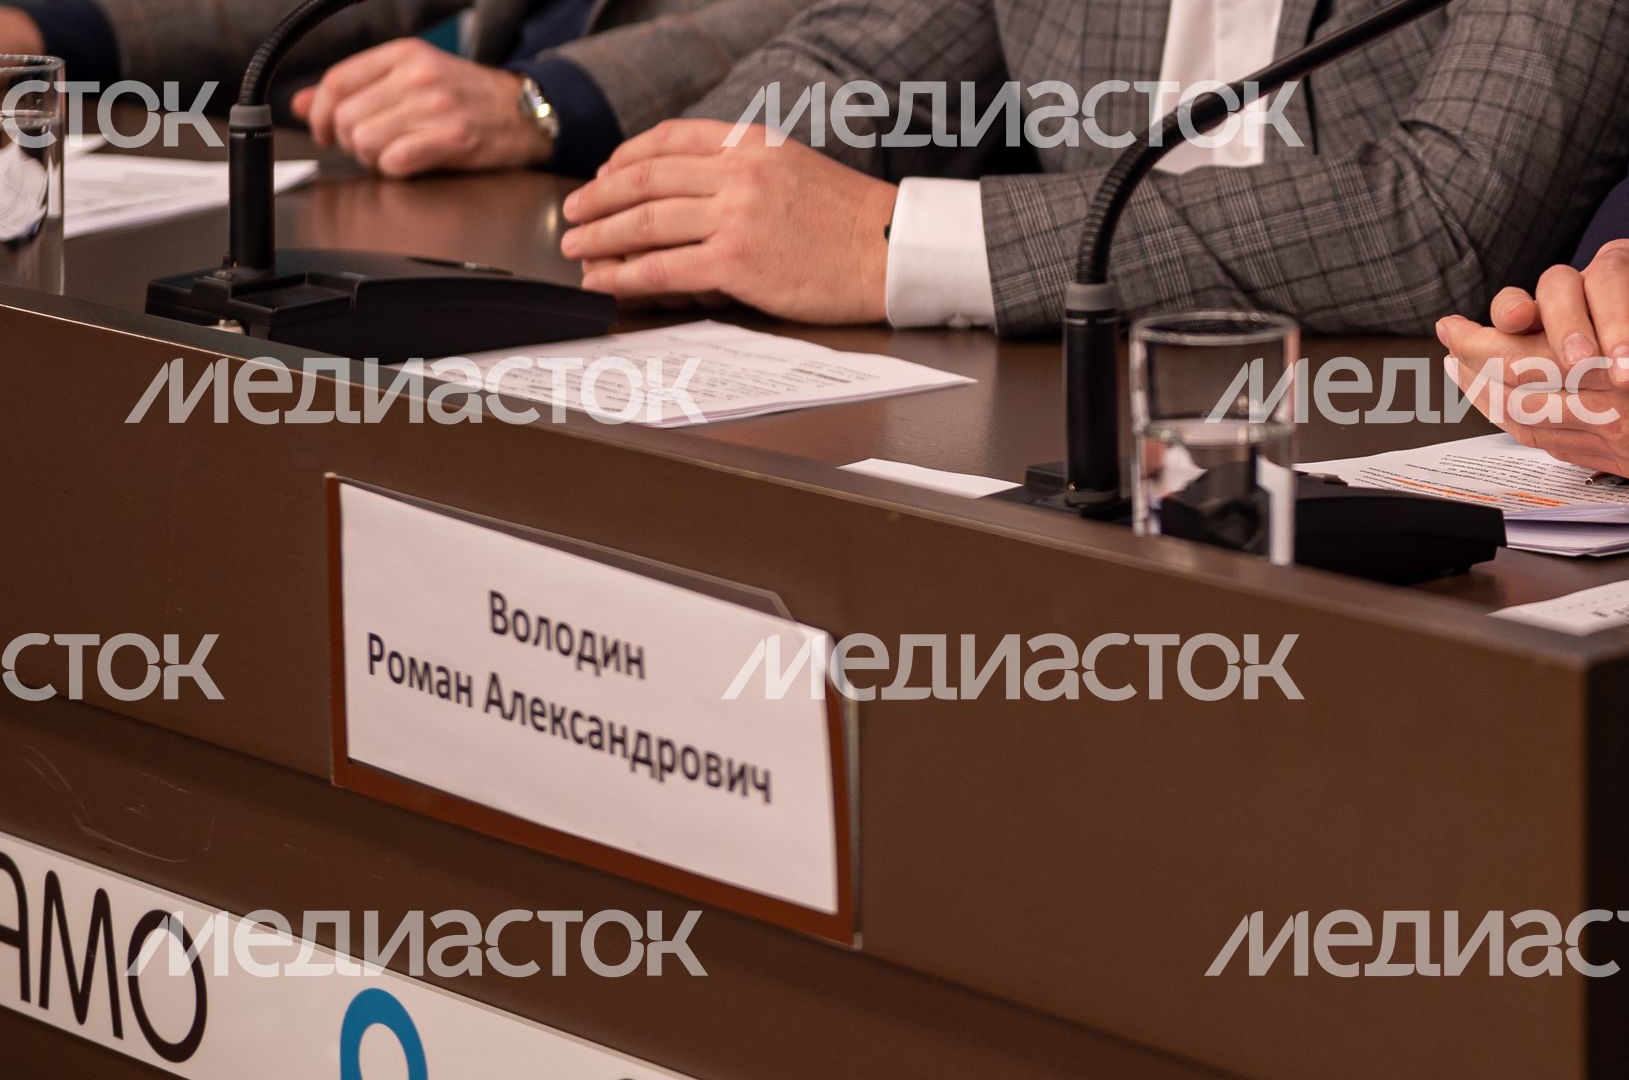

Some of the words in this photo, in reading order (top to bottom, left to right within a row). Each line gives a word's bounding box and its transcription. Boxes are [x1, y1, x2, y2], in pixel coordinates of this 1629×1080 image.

[489, 590, 647, 680] Володин
[366, 631, 474, 708] Роман
[484, 671, 774, 805] Александрович
